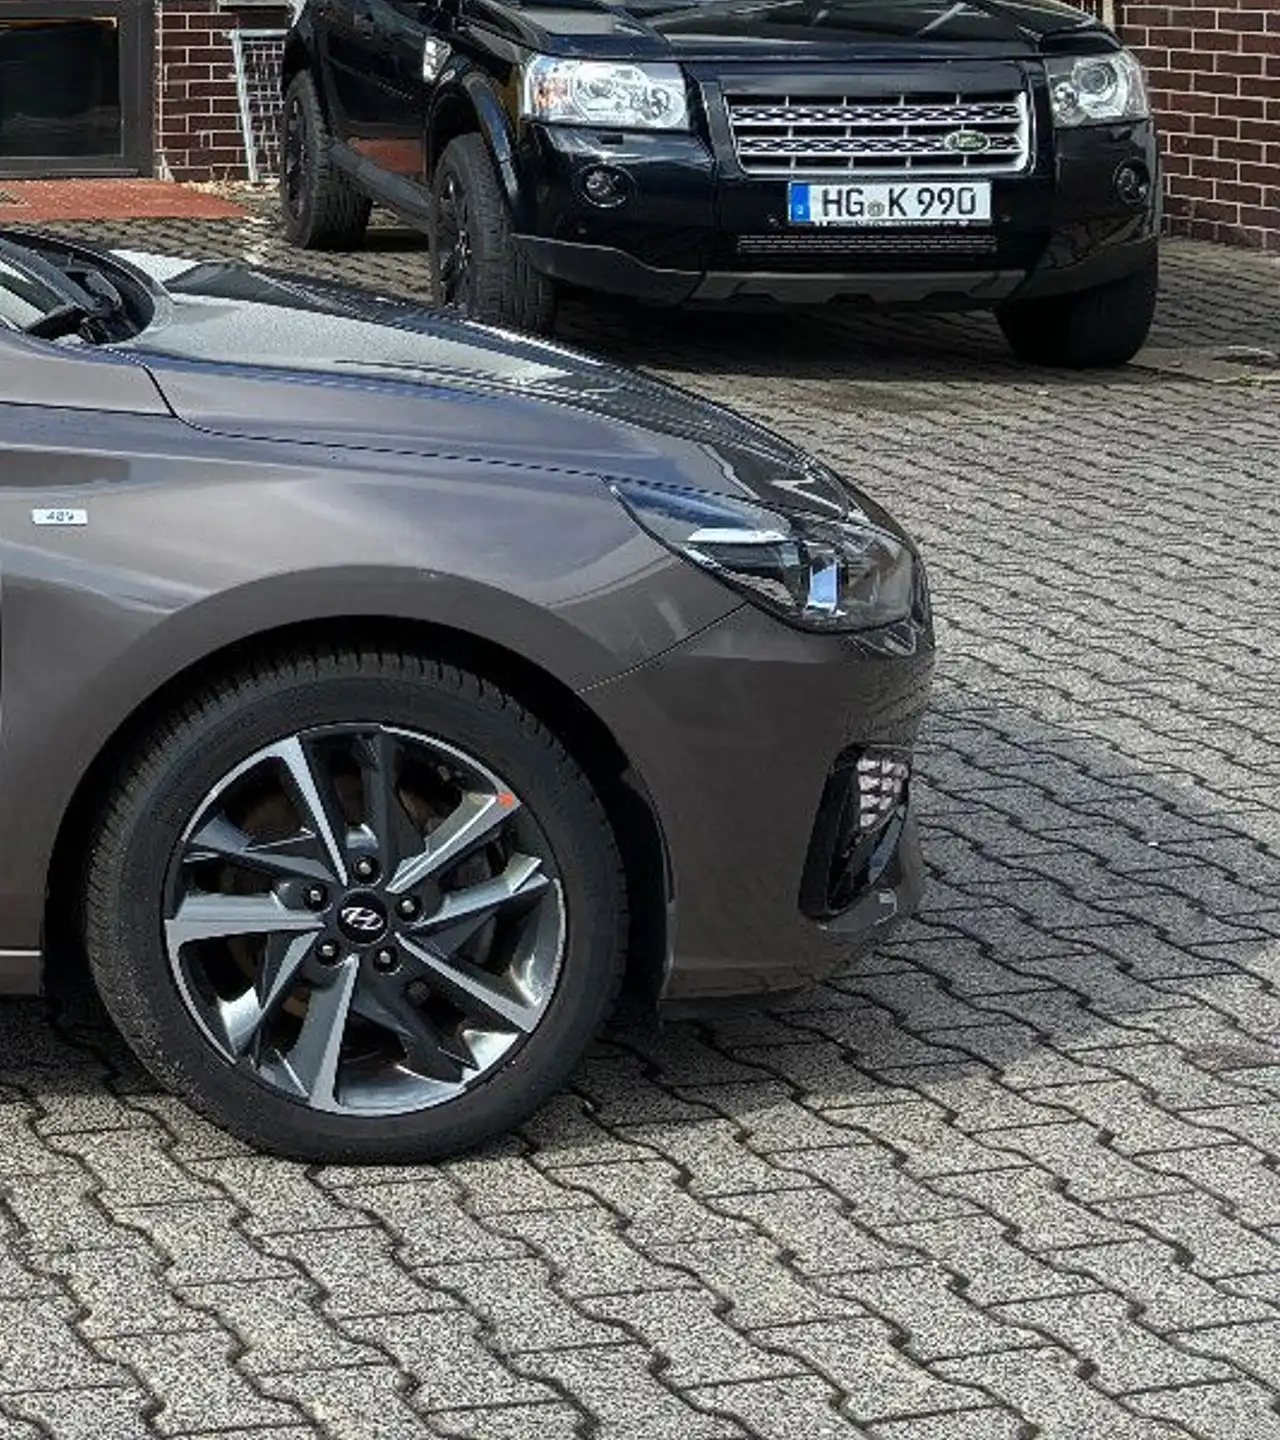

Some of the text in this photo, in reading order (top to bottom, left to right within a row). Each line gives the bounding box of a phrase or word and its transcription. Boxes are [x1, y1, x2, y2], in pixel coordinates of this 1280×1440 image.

[821, 186, 977, 216] HG K 990
